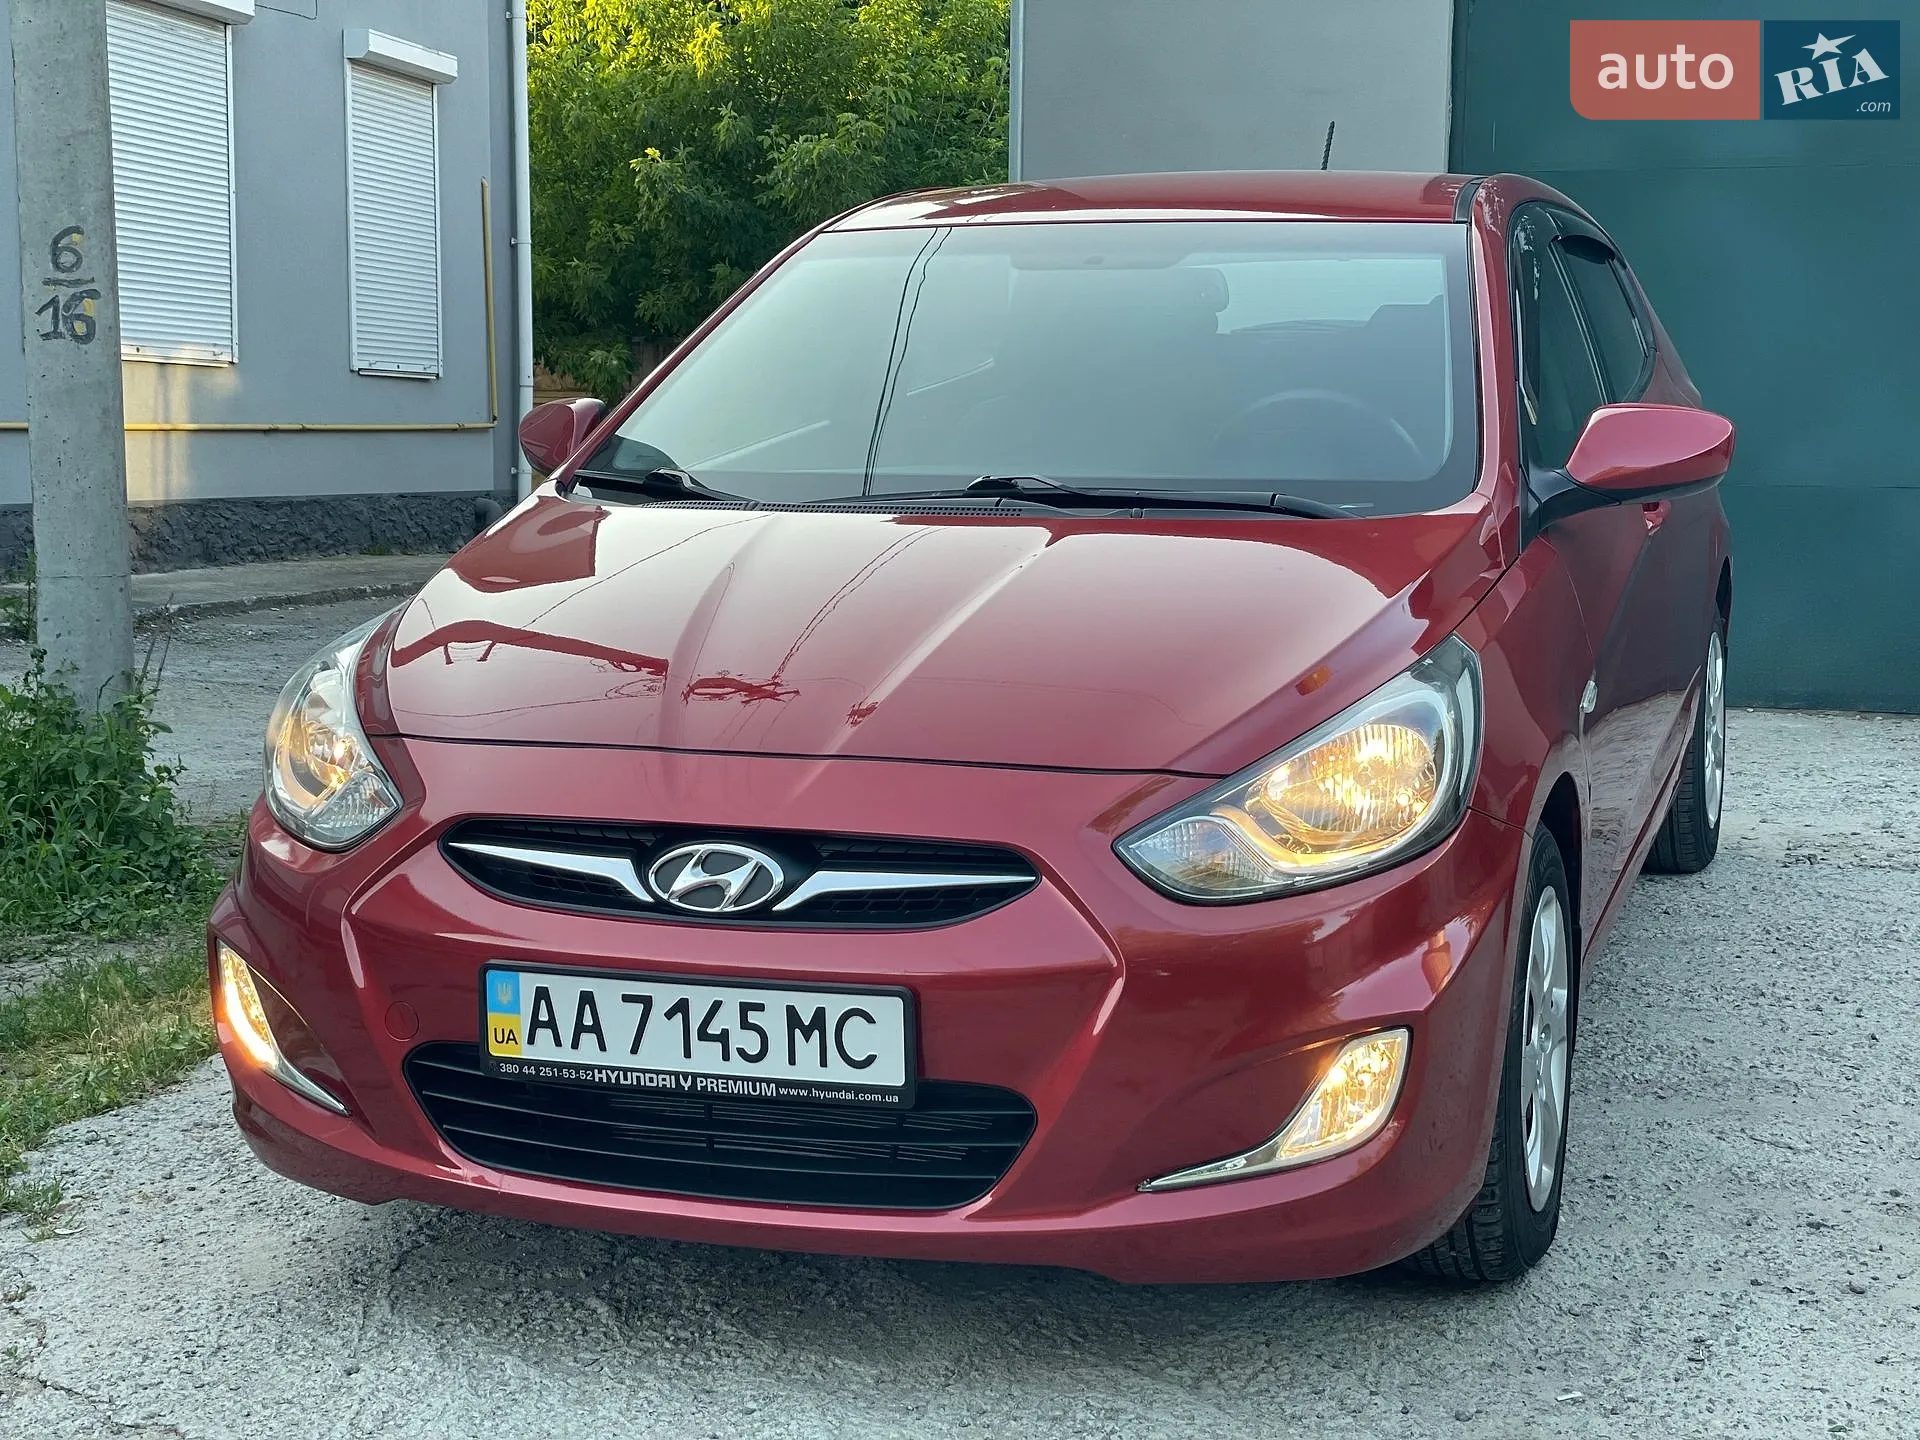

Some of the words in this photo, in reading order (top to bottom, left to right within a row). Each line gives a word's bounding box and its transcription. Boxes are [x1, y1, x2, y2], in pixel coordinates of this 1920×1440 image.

[50, 225, 84, 273] 6
[35, 288, 101, 345] 16
[494, 1027, 519, 1045] UA
[500, 1063, 519, 1074] 380
[522, 1065, 536, 1076] 44
[539, 1066, 594, 1081] 251-53-52
[594, 1068, 676, 1089] HYUNDAI
[696, 1076, 777, 1098] PREMIUM
[778, 1086, 899, 1103] www.hyundai.com.ua
